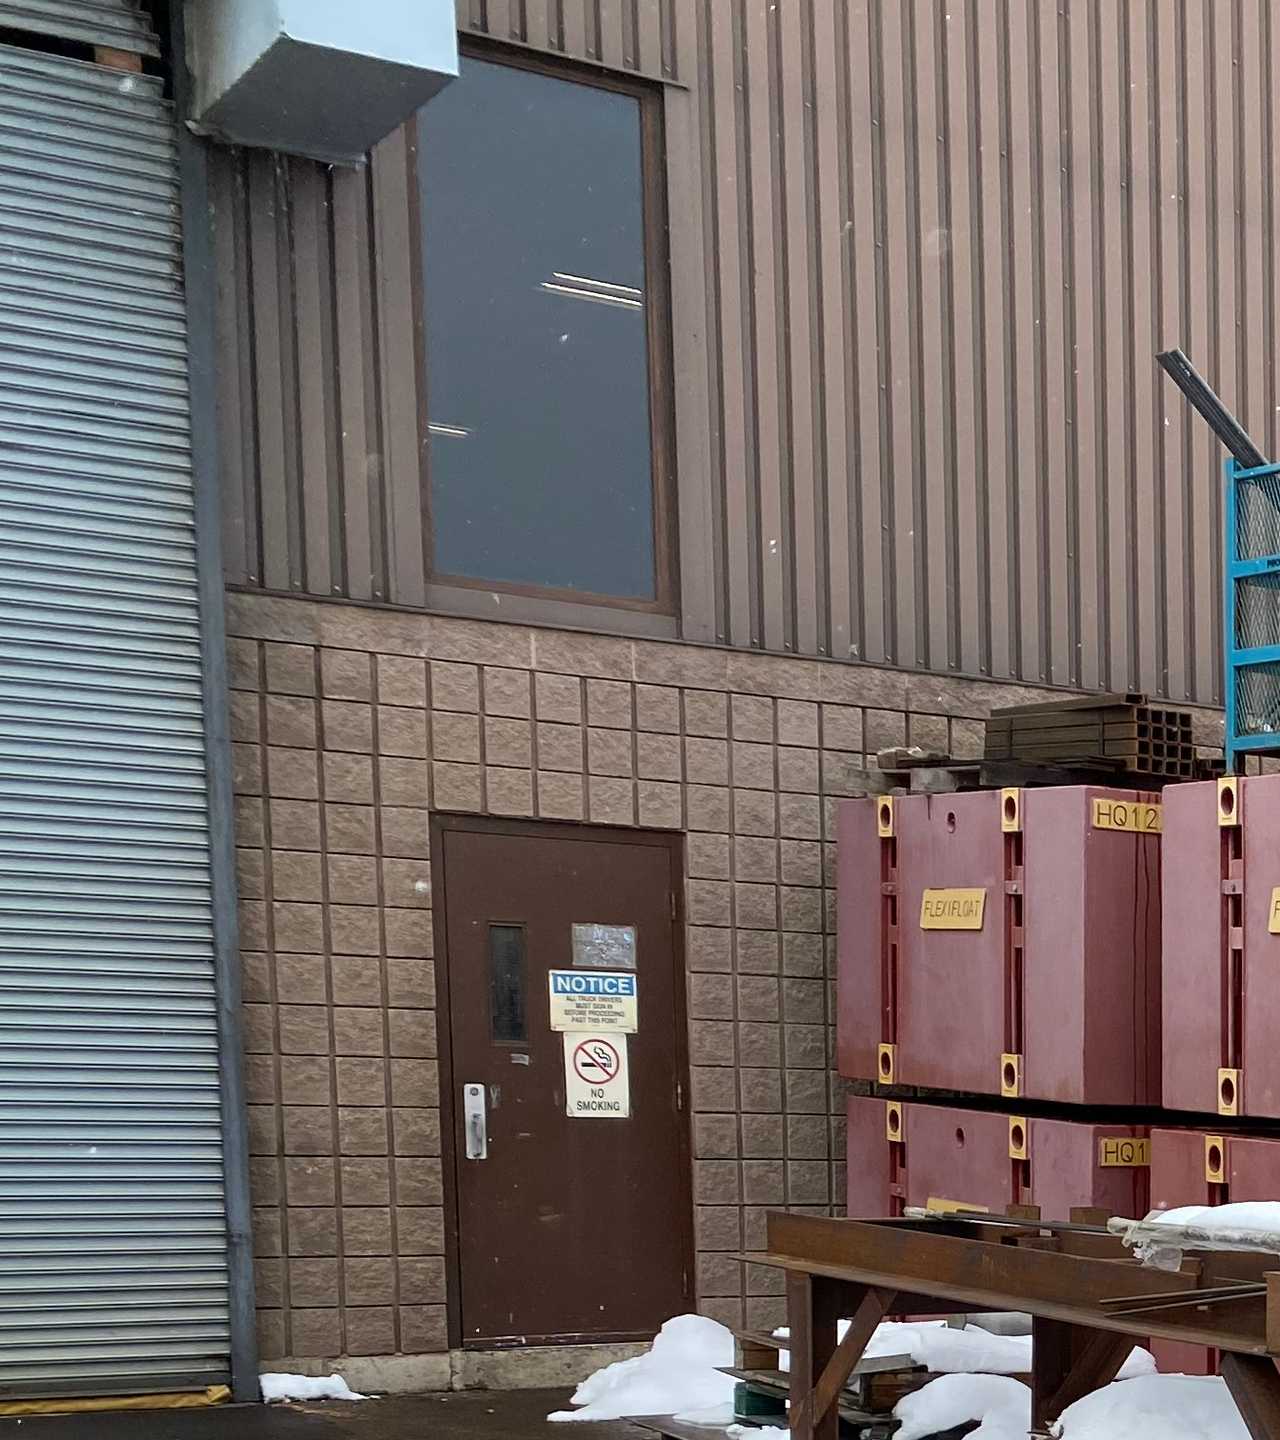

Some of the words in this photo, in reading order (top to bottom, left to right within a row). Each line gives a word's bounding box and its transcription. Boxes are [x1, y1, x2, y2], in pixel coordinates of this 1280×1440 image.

[923, 899, 982, 920] FLEXIFLOAT
[556, 976, 632, 994] NOTICE
[590, 1087, 605, 1099] NO
[576, 1100, 621, 1111] SMOKING
